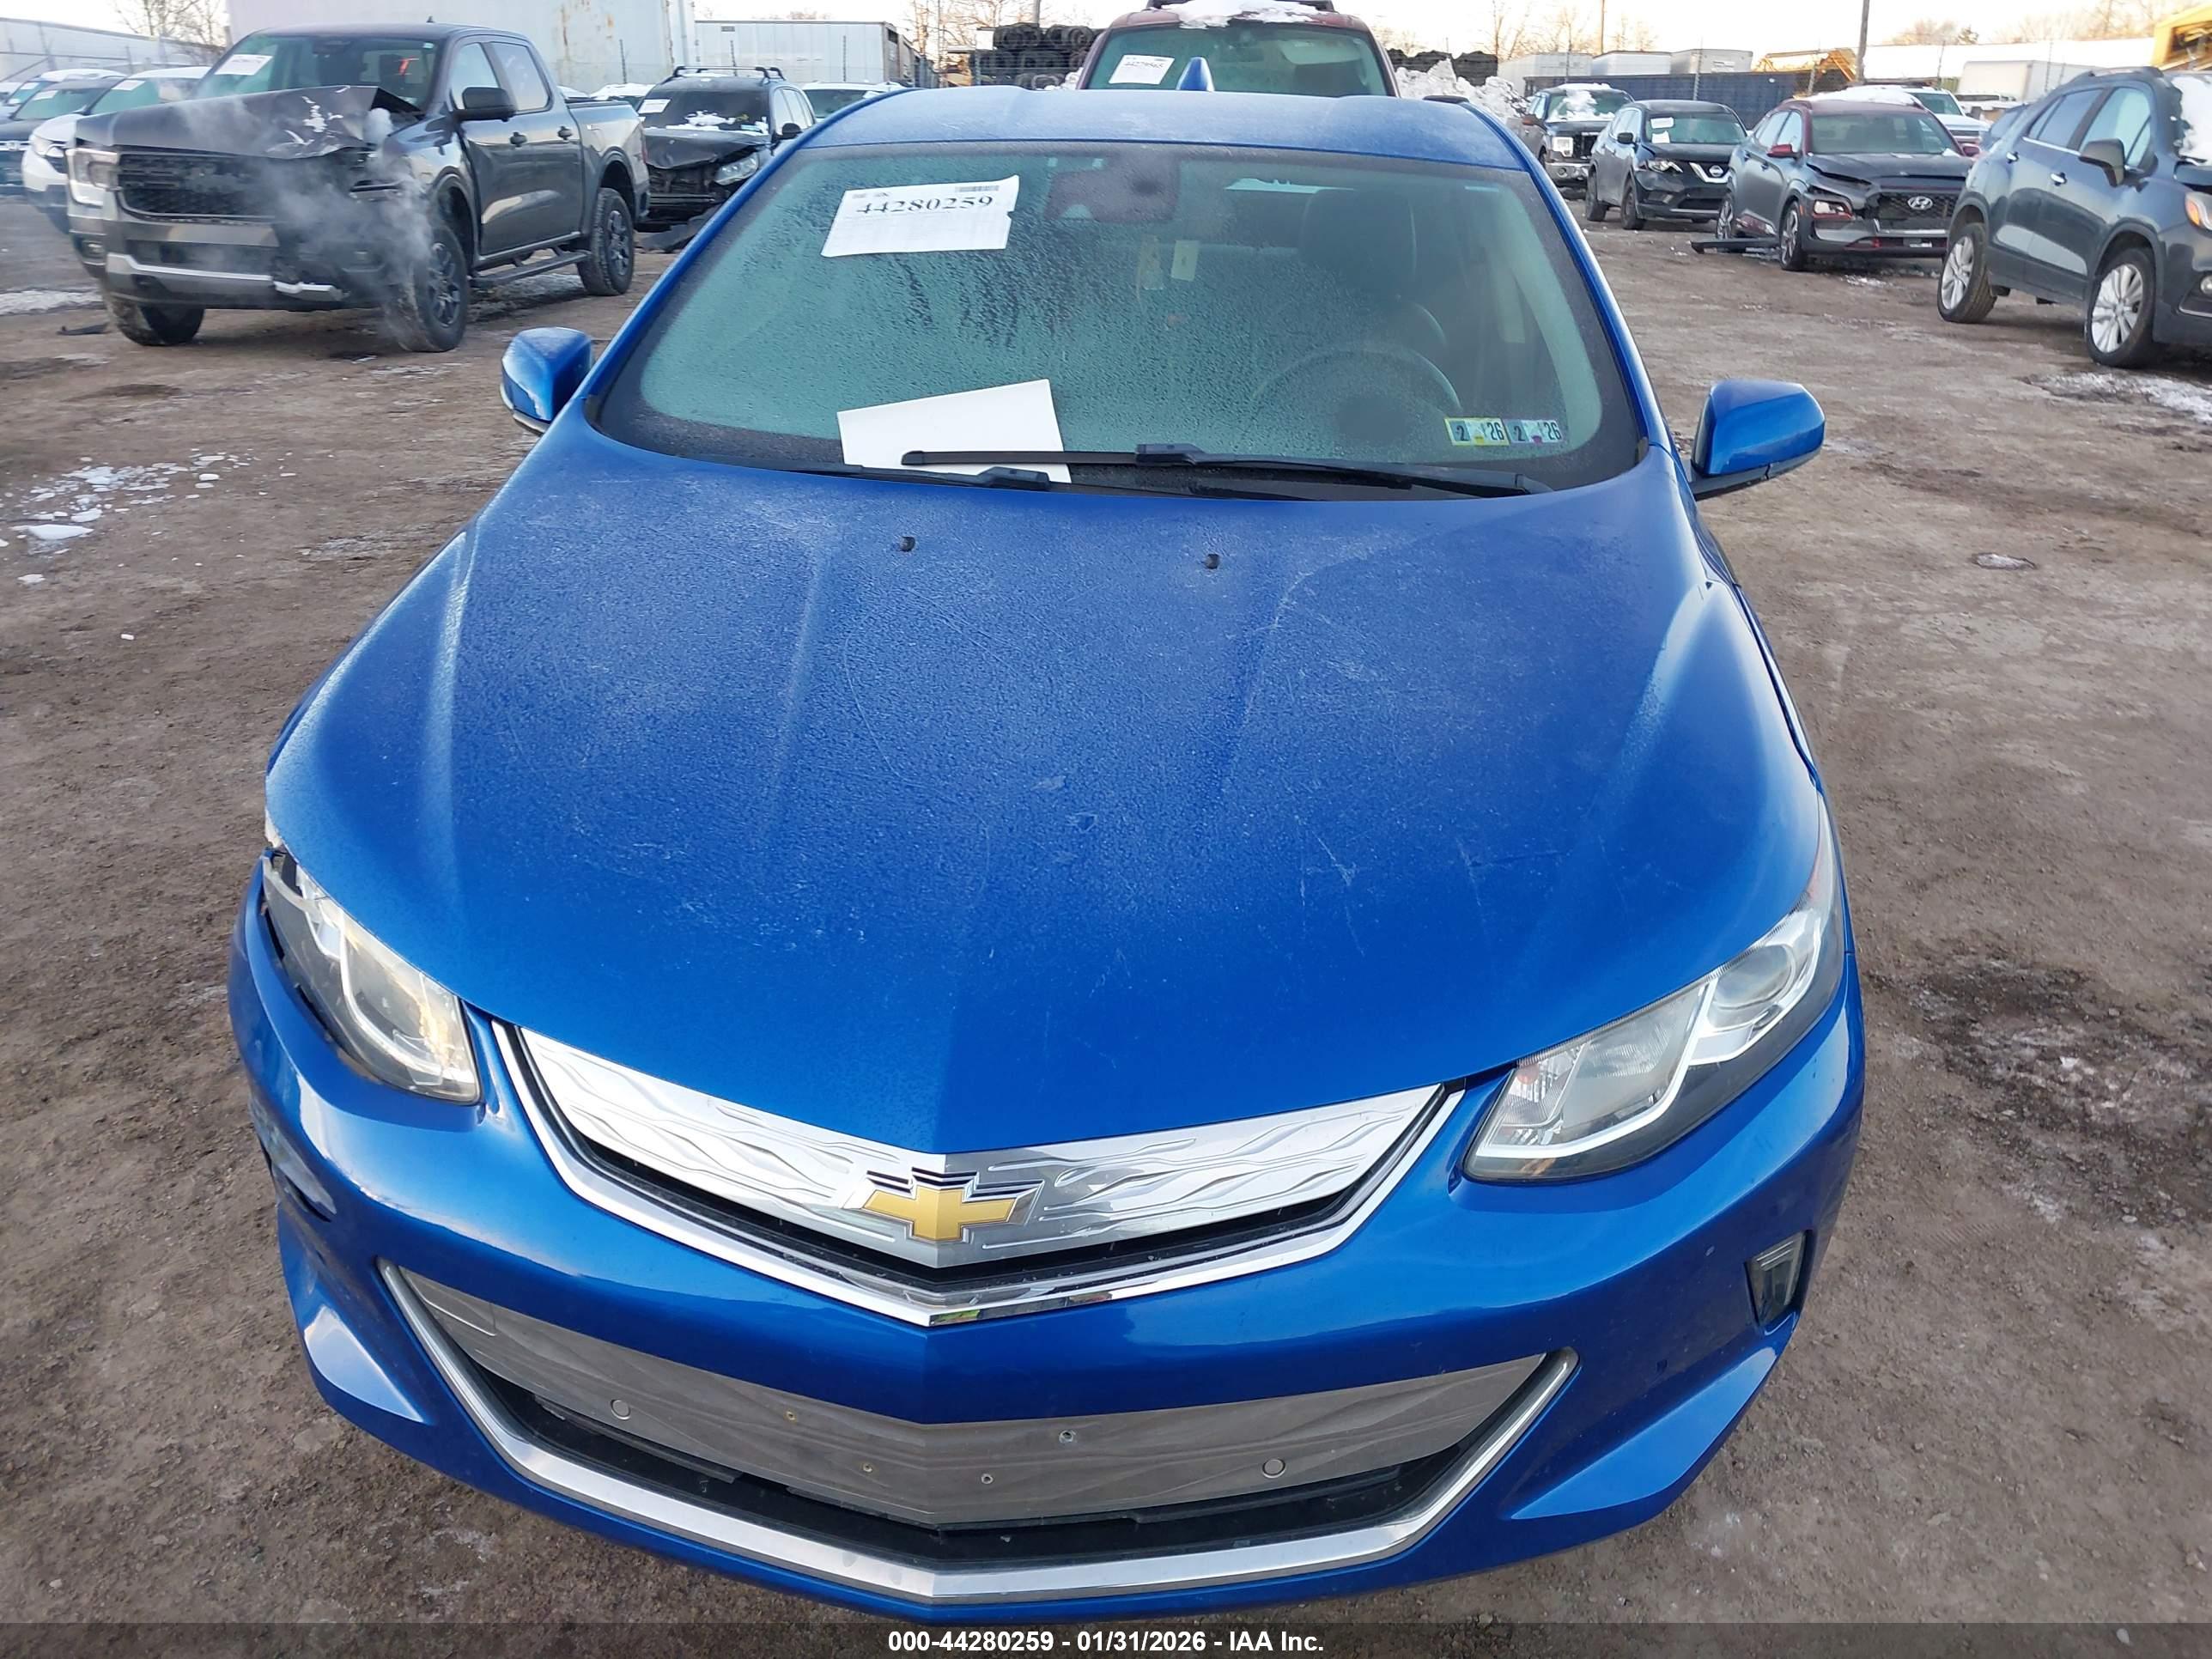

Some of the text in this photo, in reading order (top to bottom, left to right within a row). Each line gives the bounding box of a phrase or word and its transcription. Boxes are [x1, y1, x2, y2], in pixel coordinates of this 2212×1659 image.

[855, 194, 994, 214] 44280259
[1456, 425, 1468, 441] 2
[1514, 425, 1526, 441] 2
